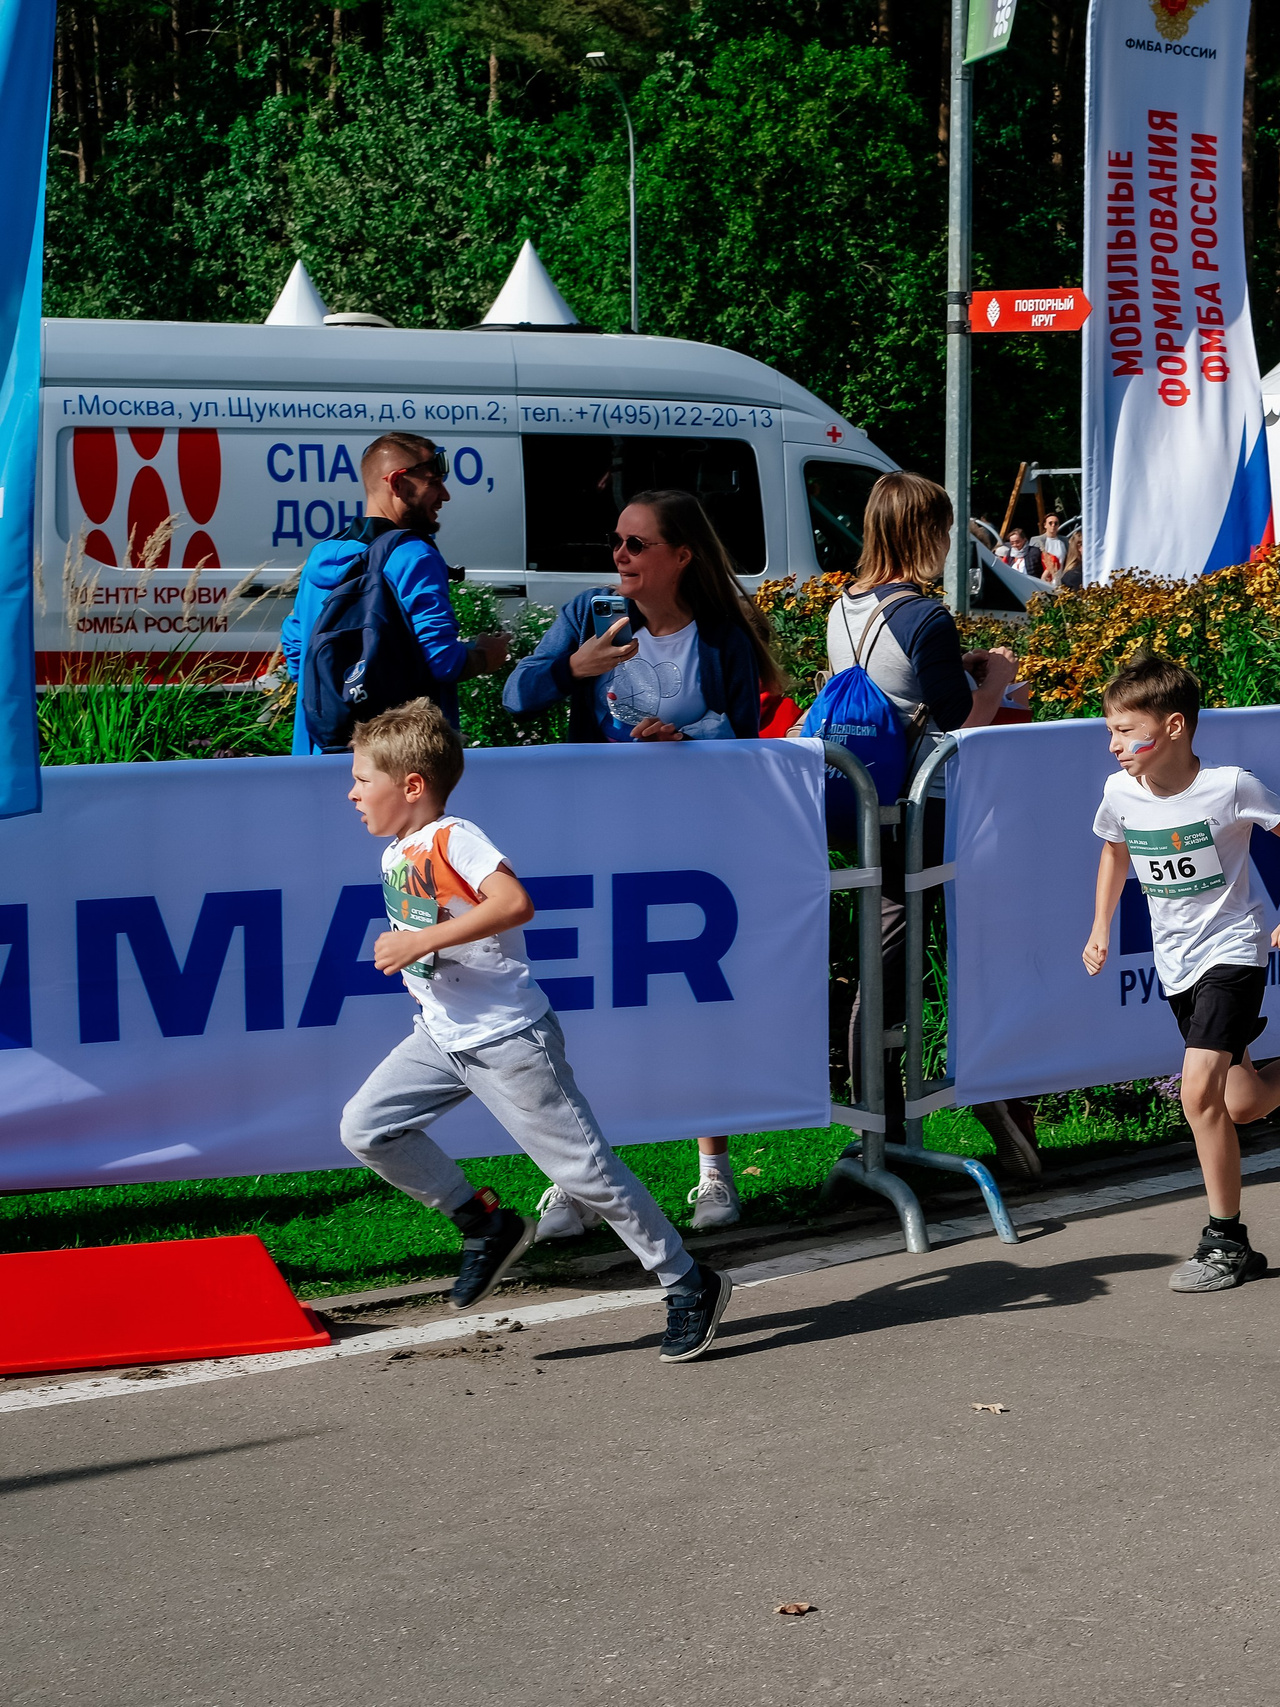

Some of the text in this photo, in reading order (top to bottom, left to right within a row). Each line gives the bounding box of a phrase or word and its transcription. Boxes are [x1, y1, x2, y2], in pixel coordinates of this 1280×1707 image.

[1125, 38, 1217, 60] ФМБА РОССИИ
[1107, 150, 1144, 377] МОБИЛЬНЫЕ
[1148, 109, 1191, 407] ФОРМИРОВАНИЯ
[1190, 133, 1231, 383] ФМБА РОССИИ
[1014, 295, 1075, 312] ПОВТОРНЫЙ
[1031, 313, 1057, 327] КРУГ
[63, 394, 183, 419] г.Москва,
[424, 400, 508, 425] корп.2;
[267, 443, 494, 493] СПАО,
[272, 500, 363, 547] ДОН
[154, 587, 227, 605] КРОВИ
[77, 616, 228, 634] ФМБА РОССИИ
[1148, 857, 1197, 881] 516
